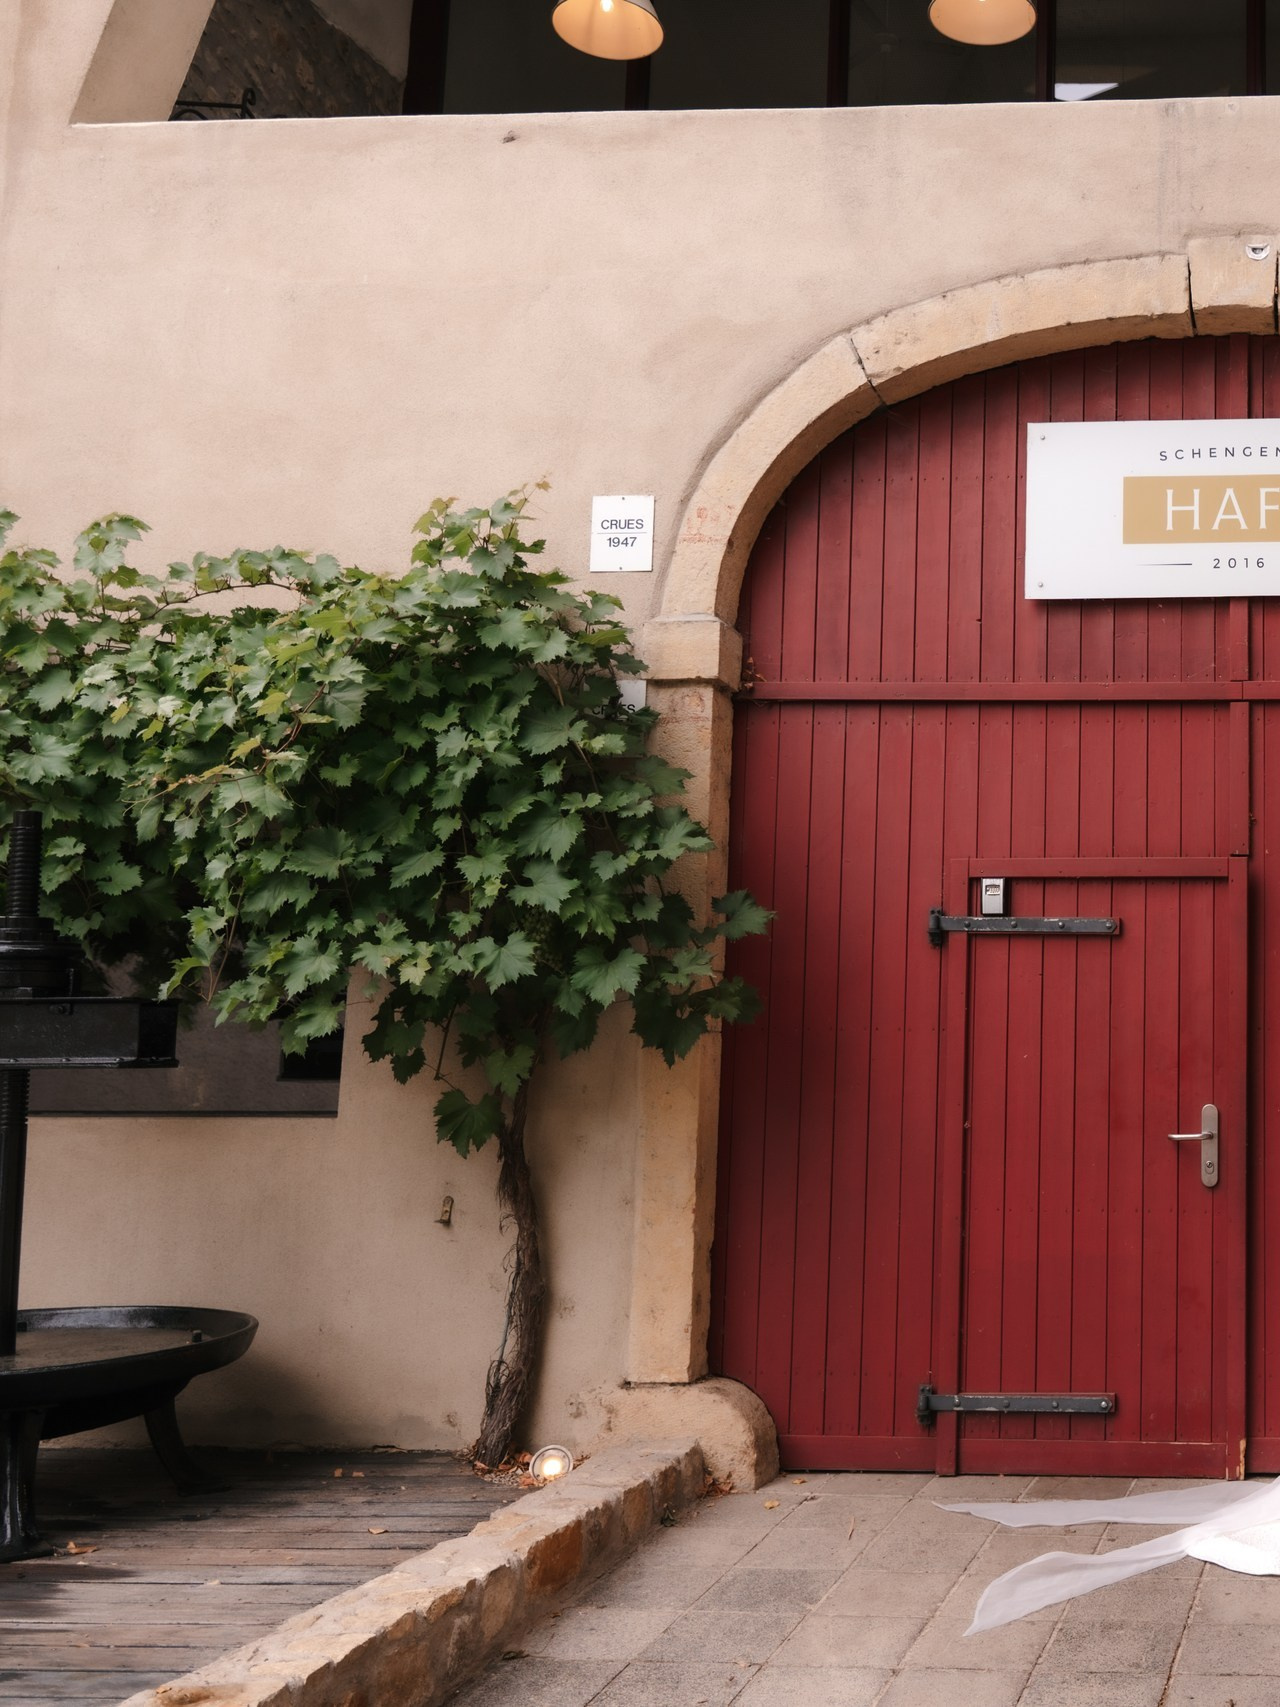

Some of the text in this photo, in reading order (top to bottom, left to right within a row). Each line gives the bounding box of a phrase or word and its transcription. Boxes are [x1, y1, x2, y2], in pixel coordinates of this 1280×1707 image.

[600, 518, 644, 530] CRUES
[606, 536, 638, 548] 1947
[1212, 557, 1265, 569] 2016
